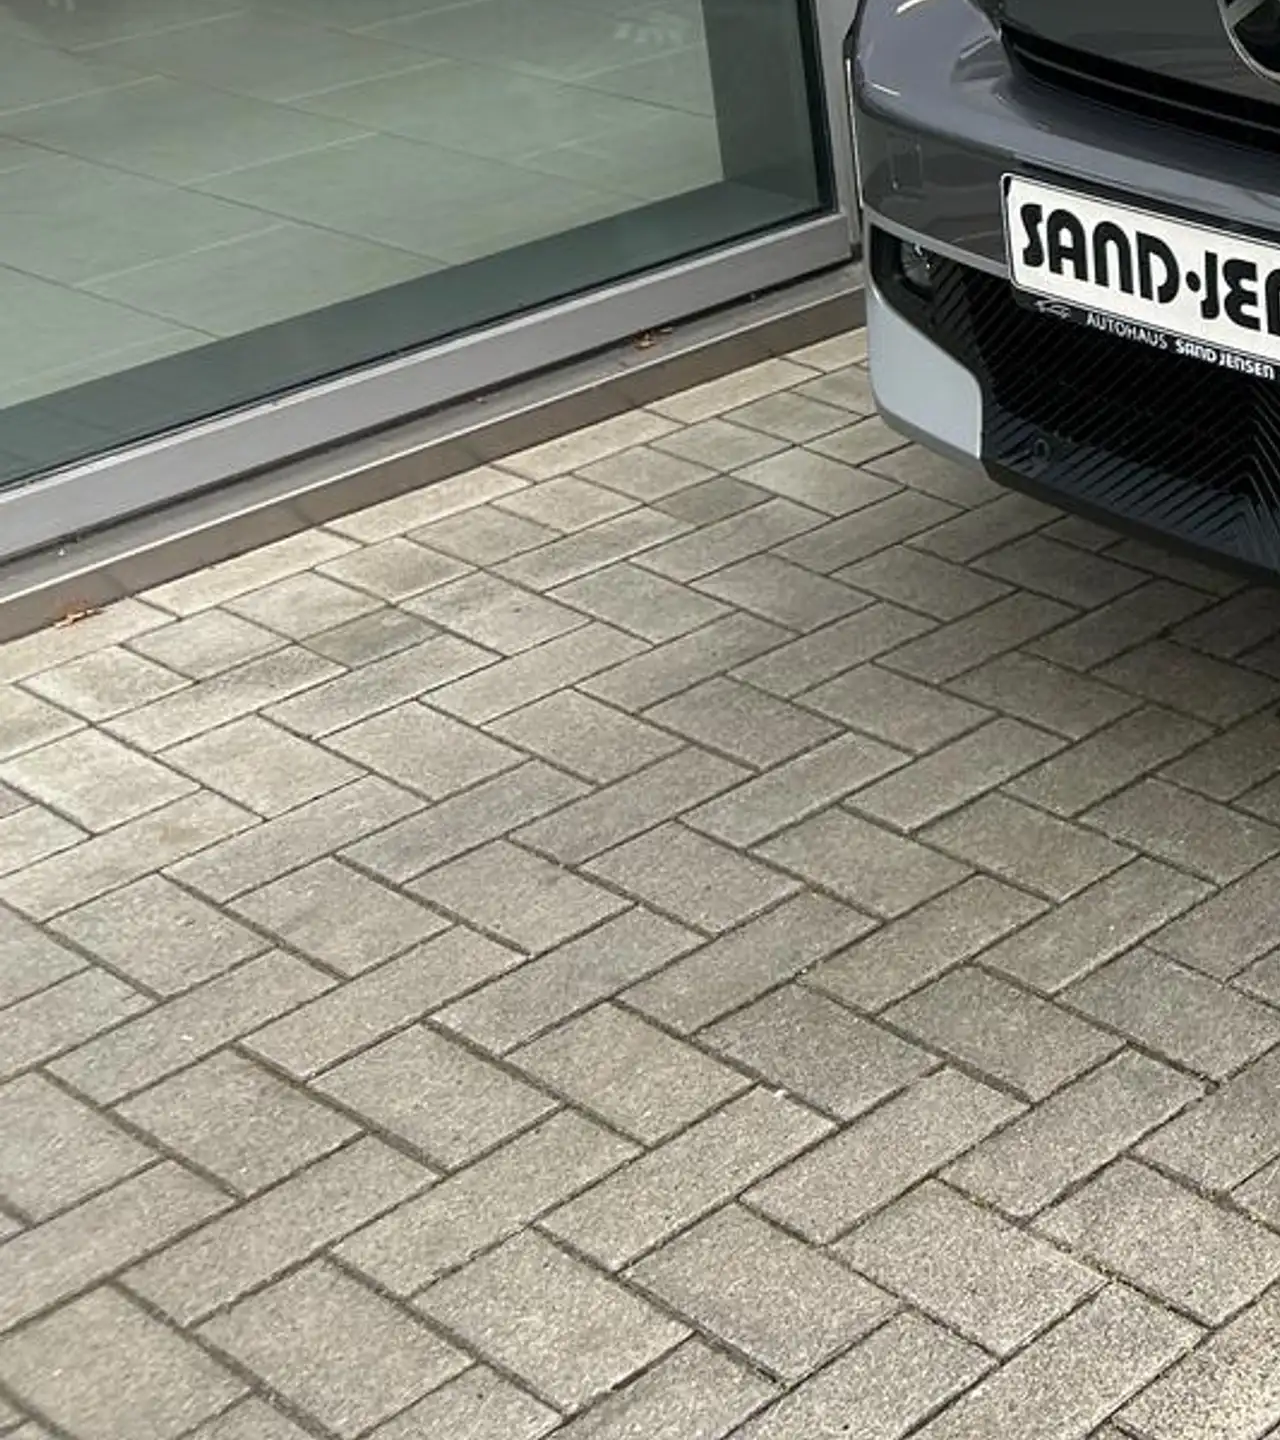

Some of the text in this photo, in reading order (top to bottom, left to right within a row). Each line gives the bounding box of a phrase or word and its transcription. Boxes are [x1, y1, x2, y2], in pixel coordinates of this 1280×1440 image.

[1085, 311, 1170, 350] AUTOHAUS
[1175, 338, 1217, 364] SAND
[1218, 351, 1276, 382] JENSEN
